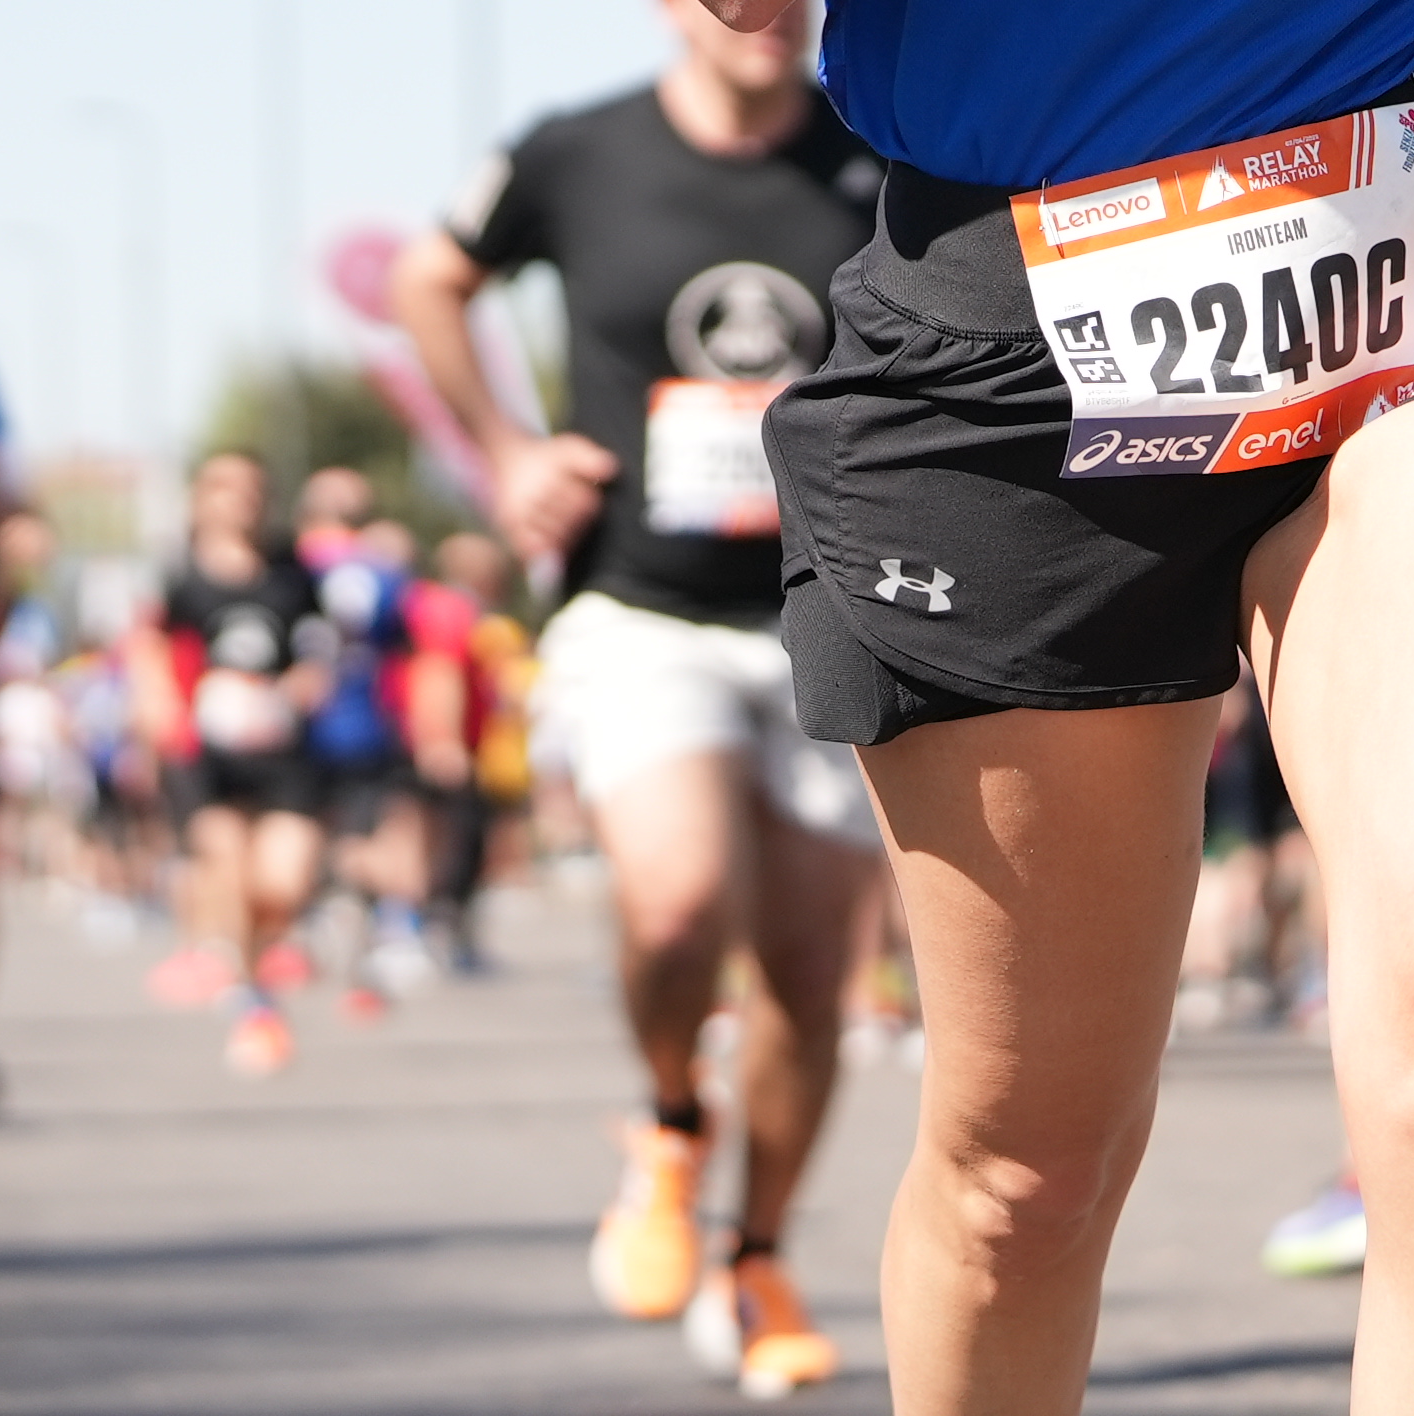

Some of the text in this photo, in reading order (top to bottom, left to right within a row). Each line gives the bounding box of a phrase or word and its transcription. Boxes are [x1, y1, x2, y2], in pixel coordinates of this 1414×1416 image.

[1242, 140, 1322, 179] RELAY
[1248, 162, 1329, 192] MARATHON
[1052, 195, 1150, 232] Lenovo
[1227, 217, 1309, 256] IRONTEAM
[1130, 237, 1406, 395] 2240C
[1116, 434, 1214, 465] asics
[1237, 407, 1325, 461] enel
